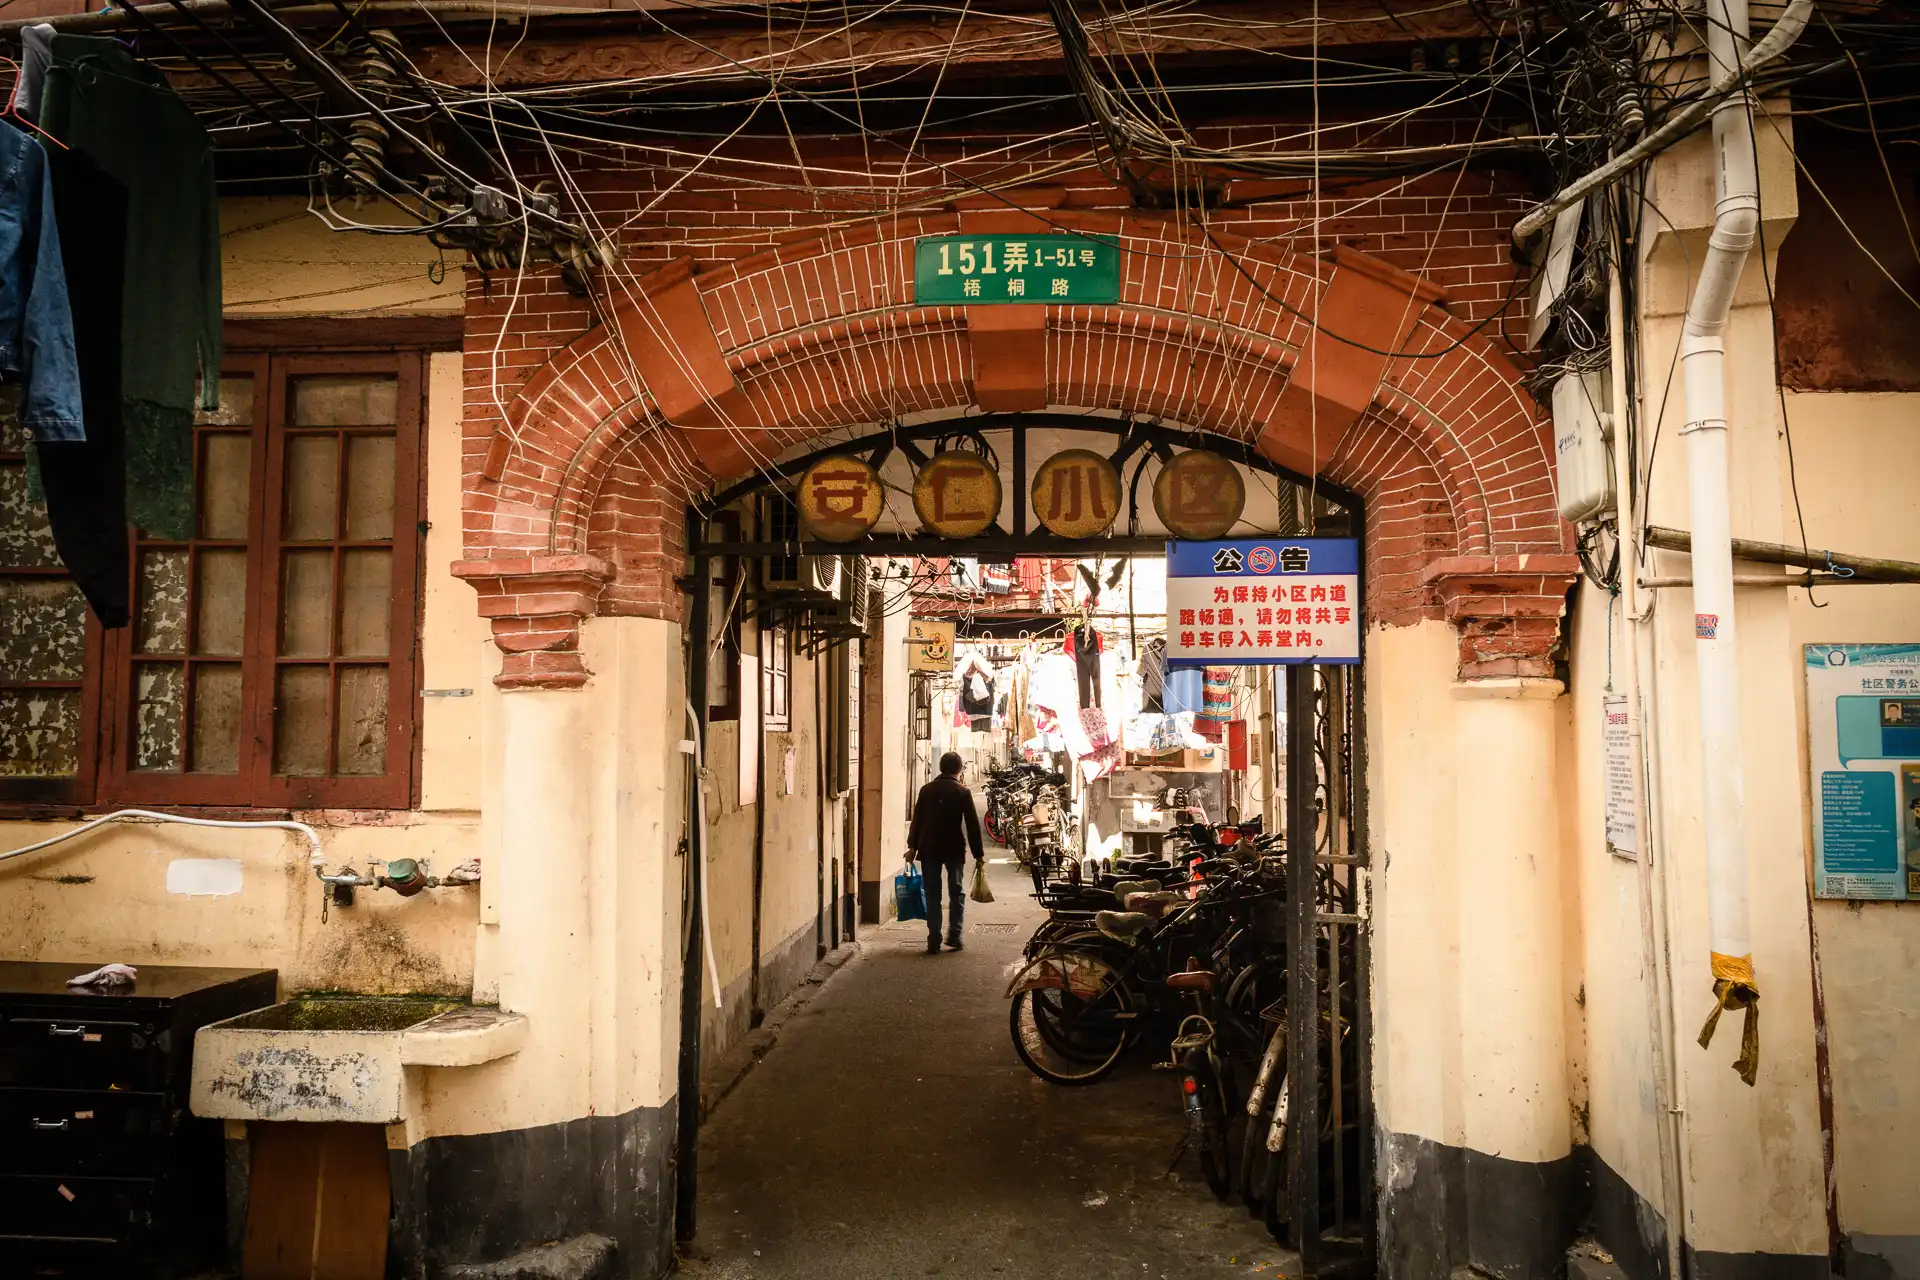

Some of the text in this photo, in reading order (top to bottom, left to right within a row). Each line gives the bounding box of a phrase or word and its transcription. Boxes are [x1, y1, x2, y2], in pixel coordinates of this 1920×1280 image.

[964, 279, 1069, 296] 梧桐路
[1212, 547, 1310, 572] 公告
[1214, 585, 1346, 603] 为保持小区内道
[1180, 607, 1350, 626] 路畅通，请勿将共享
[1180, 630, 1324, 648] 单车停入弄堂内。
